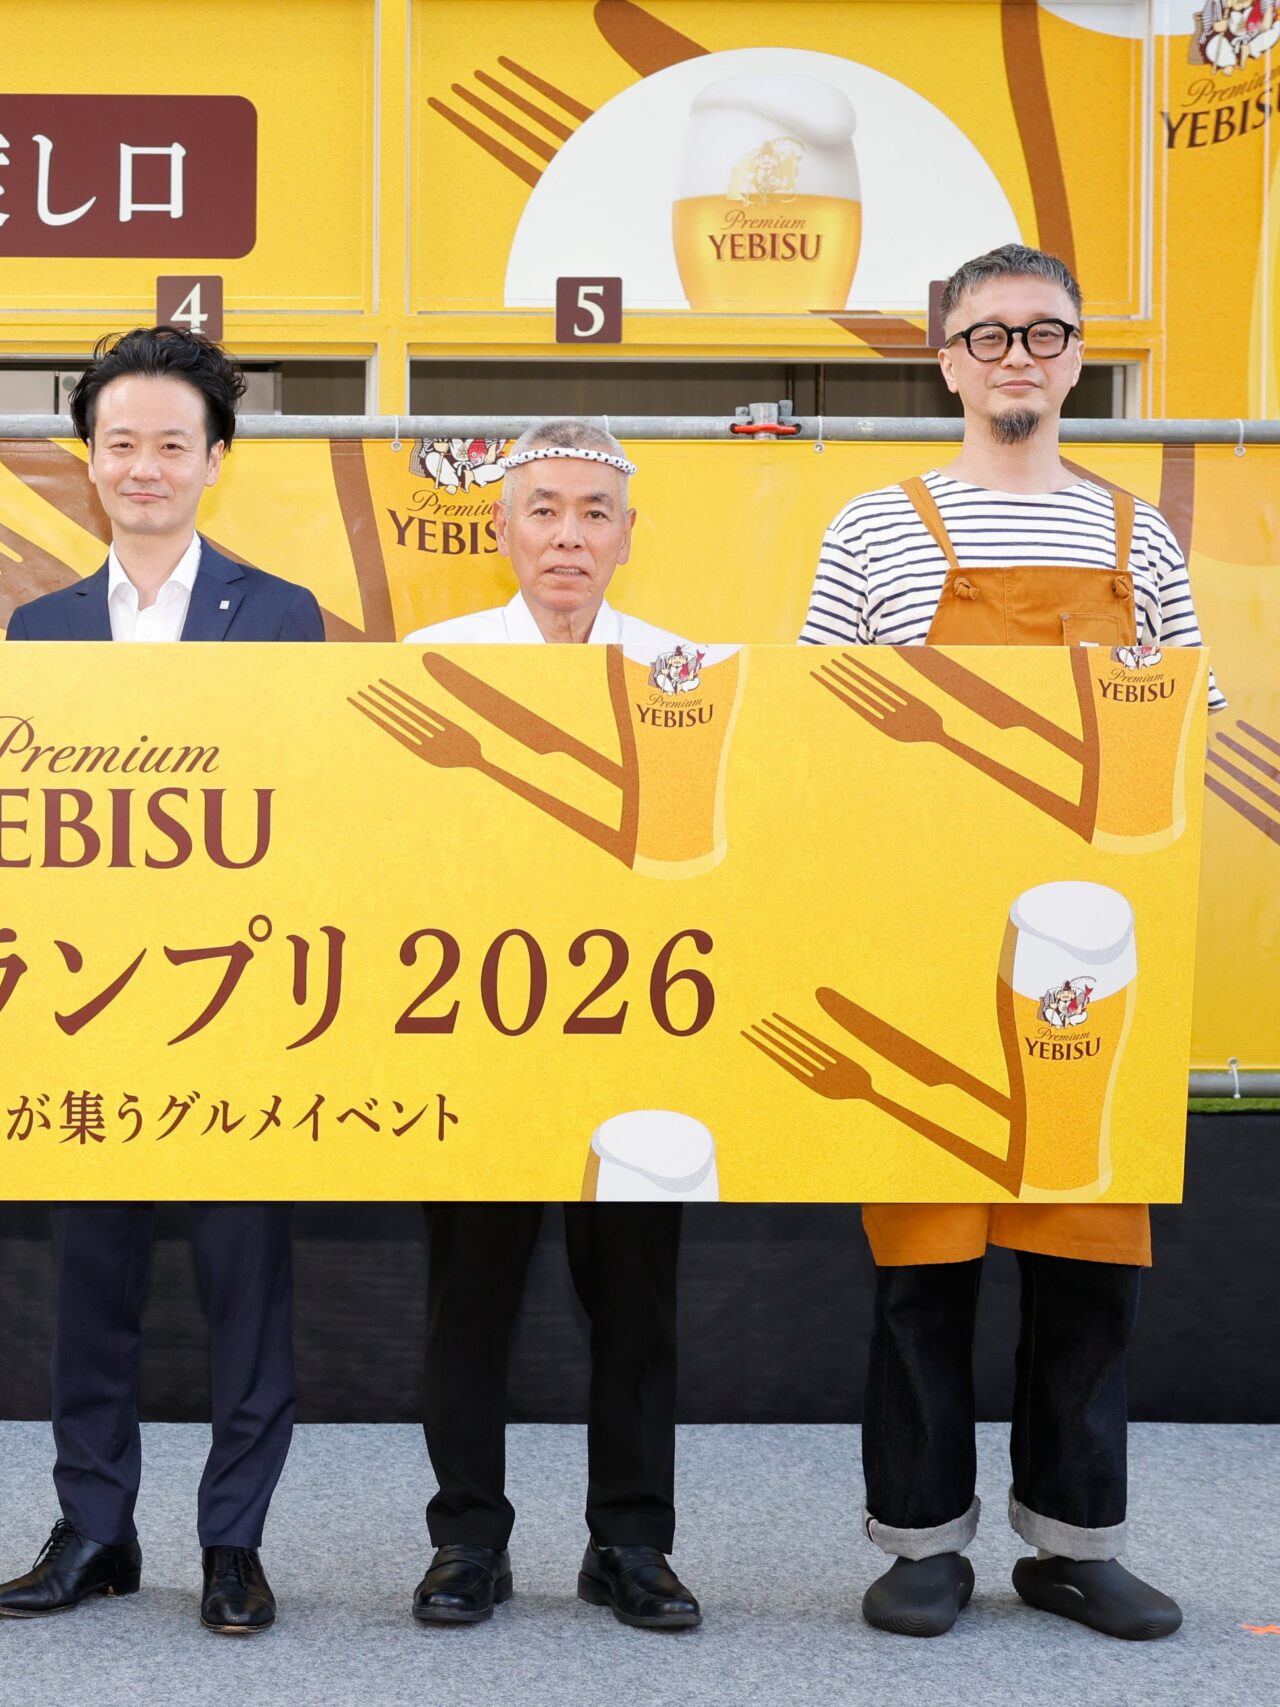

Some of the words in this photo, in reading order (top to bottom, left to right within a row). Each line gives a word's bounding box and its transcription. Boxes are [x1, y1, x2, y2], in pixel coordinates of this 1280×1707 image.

[1160, 83, 1280, 149] YEBIS
[720, 209, 807, 230] Premium
[708, 232, 822, 261] YEBISU
[170, 282, 208, 334] 4
[573, 285, 605, 337] 5
[406, 489, 494, 516] Premiu
[386, 507, 498, 555] YEBIS
[1108, 668, 1165, 683] Premium
[646, 693, 703, 709] Premium
[1098, 678, 1176, 702] YEBISU
[636, 703, 714, 728] YEBISU
[394, 928, 715, 1037] 2026
[1034, 1026, 1090, 1041] Premium
[1024, 1036, 1101, 1060] YEBISU
